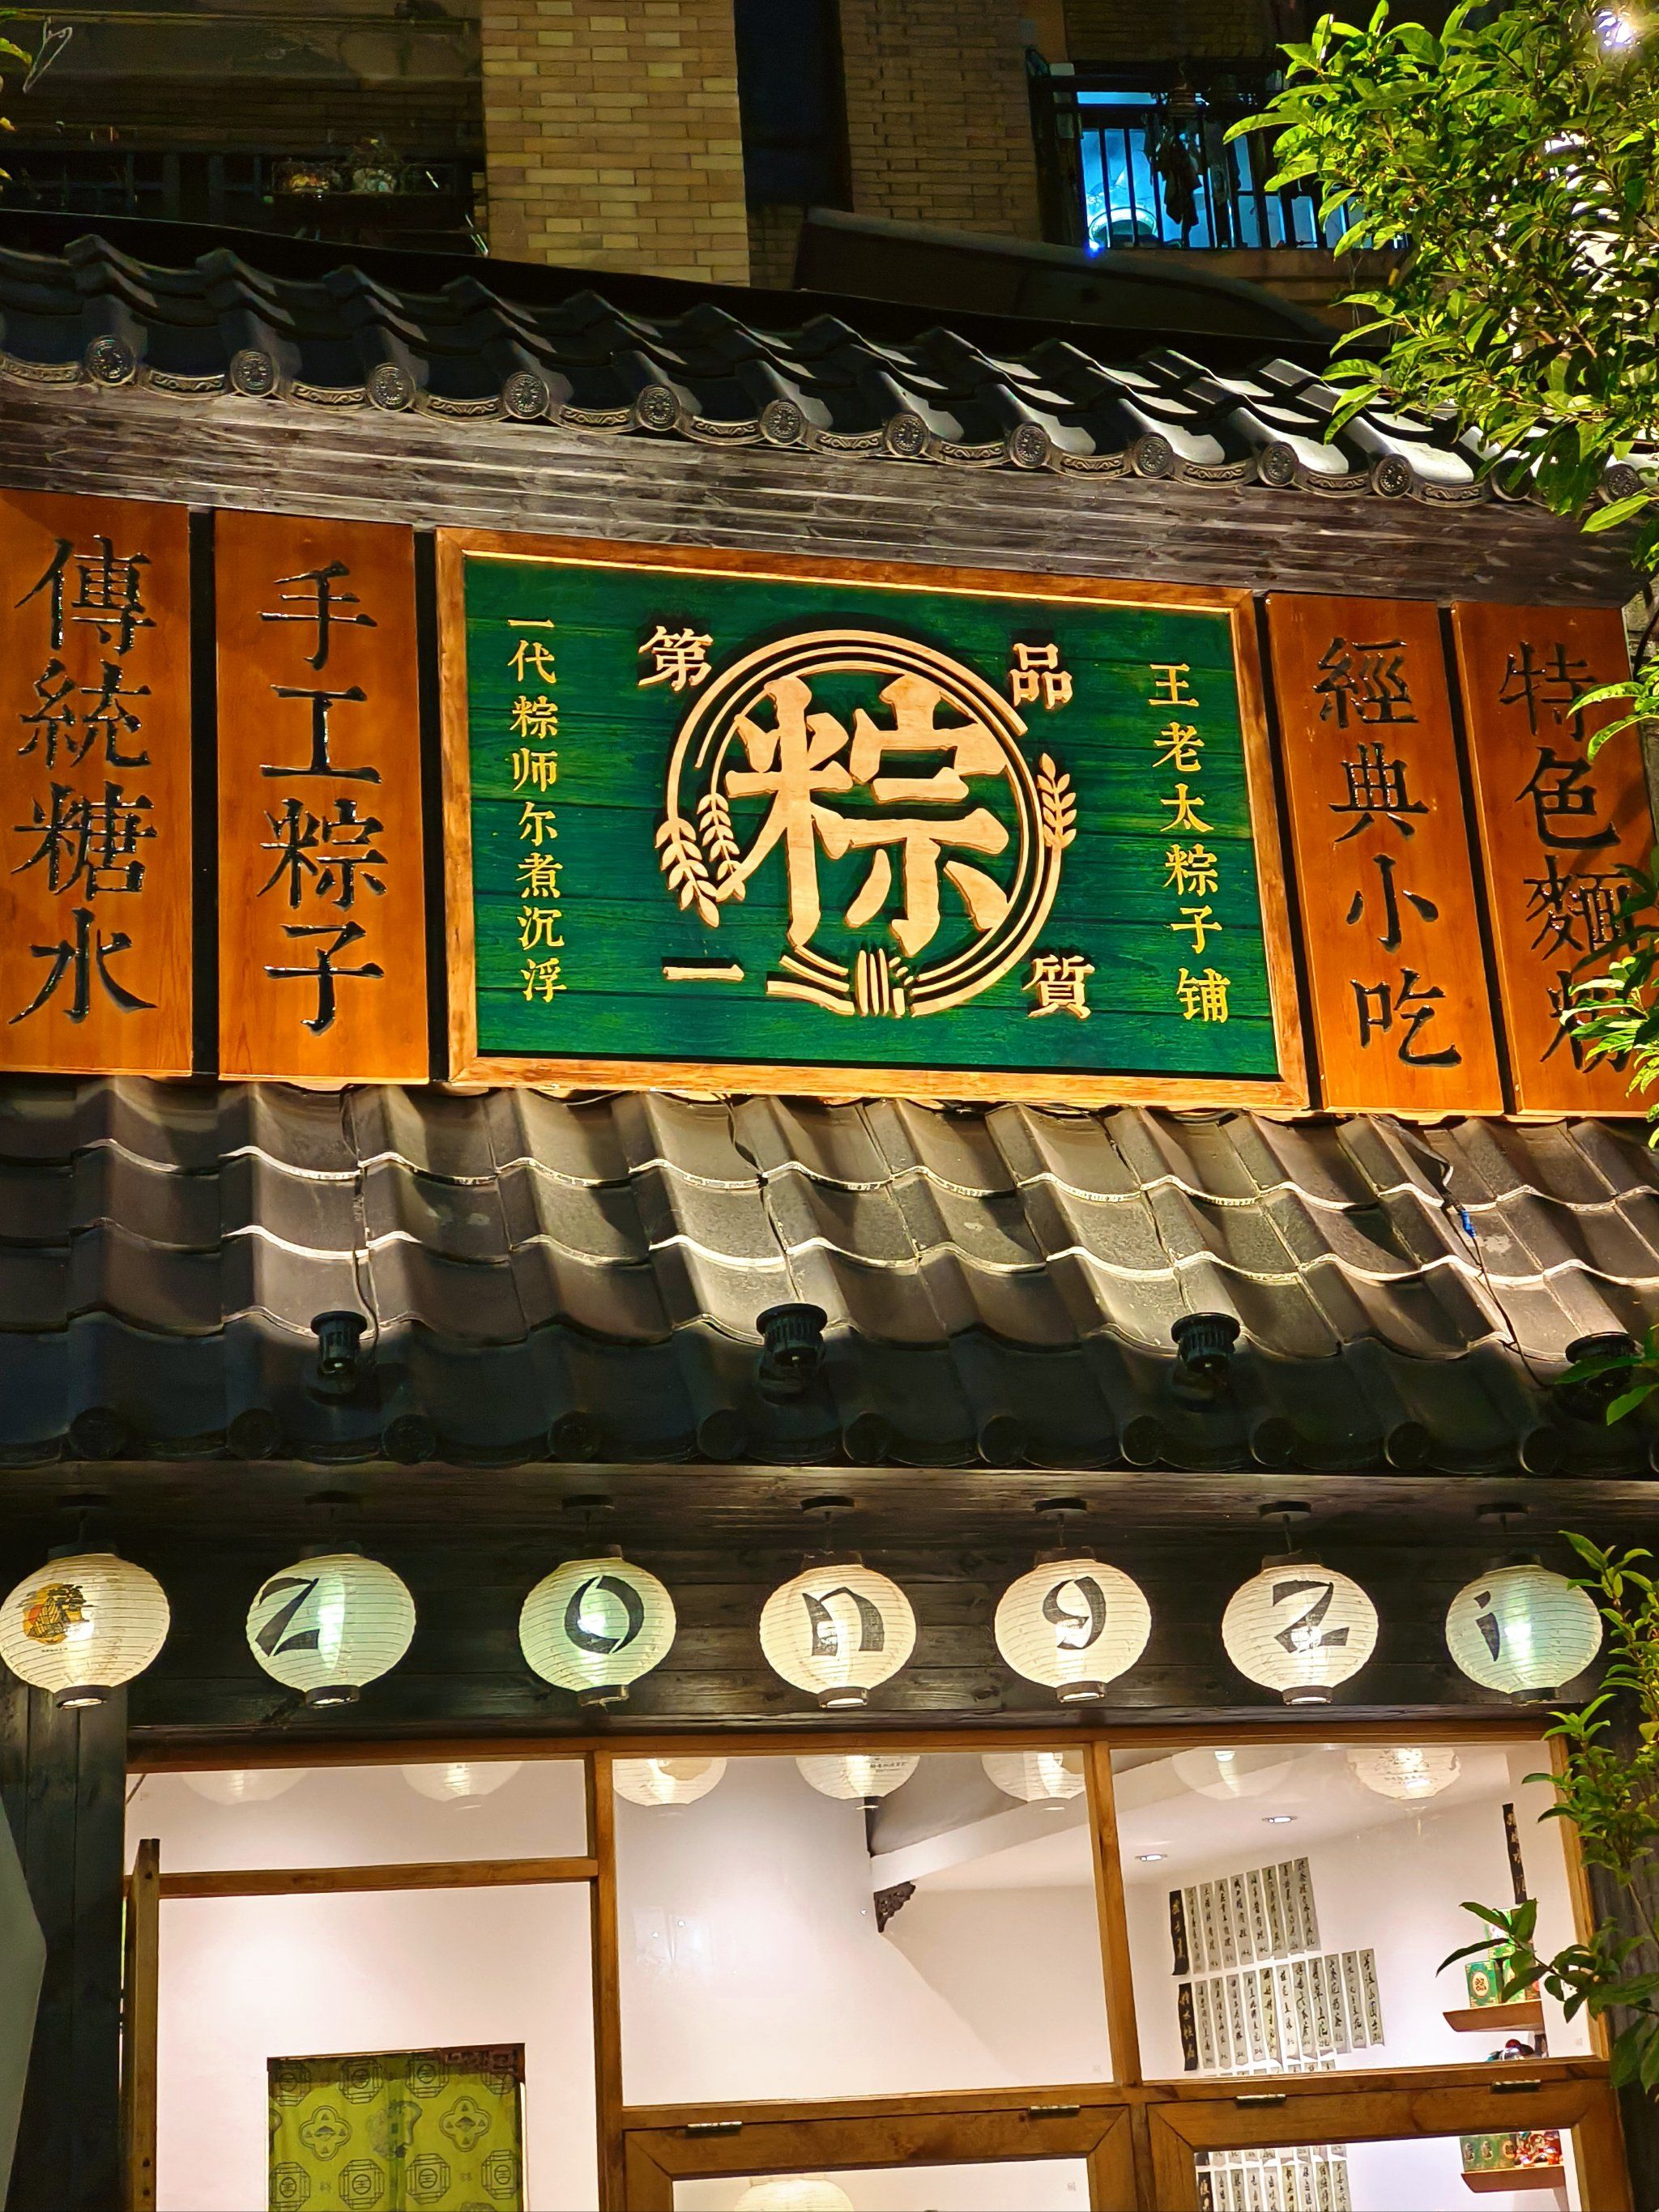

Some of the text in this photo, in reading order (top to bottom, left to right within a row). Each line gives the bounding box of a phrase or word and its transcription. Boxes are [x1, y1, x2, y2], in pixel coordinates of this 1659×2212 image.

[9, 535, 157, 1024] 傳統糖水
[257, 560, 388, 1036] 手工粽子
[508, 616, 566, 1004] 一代粽师尔煮沉浮
[716, 675, 1010, 957] 粽
[1148, 663, 1231, 1023] 王老太粽子铺
[1313, 637, 1461, 1068] 經典小吃
